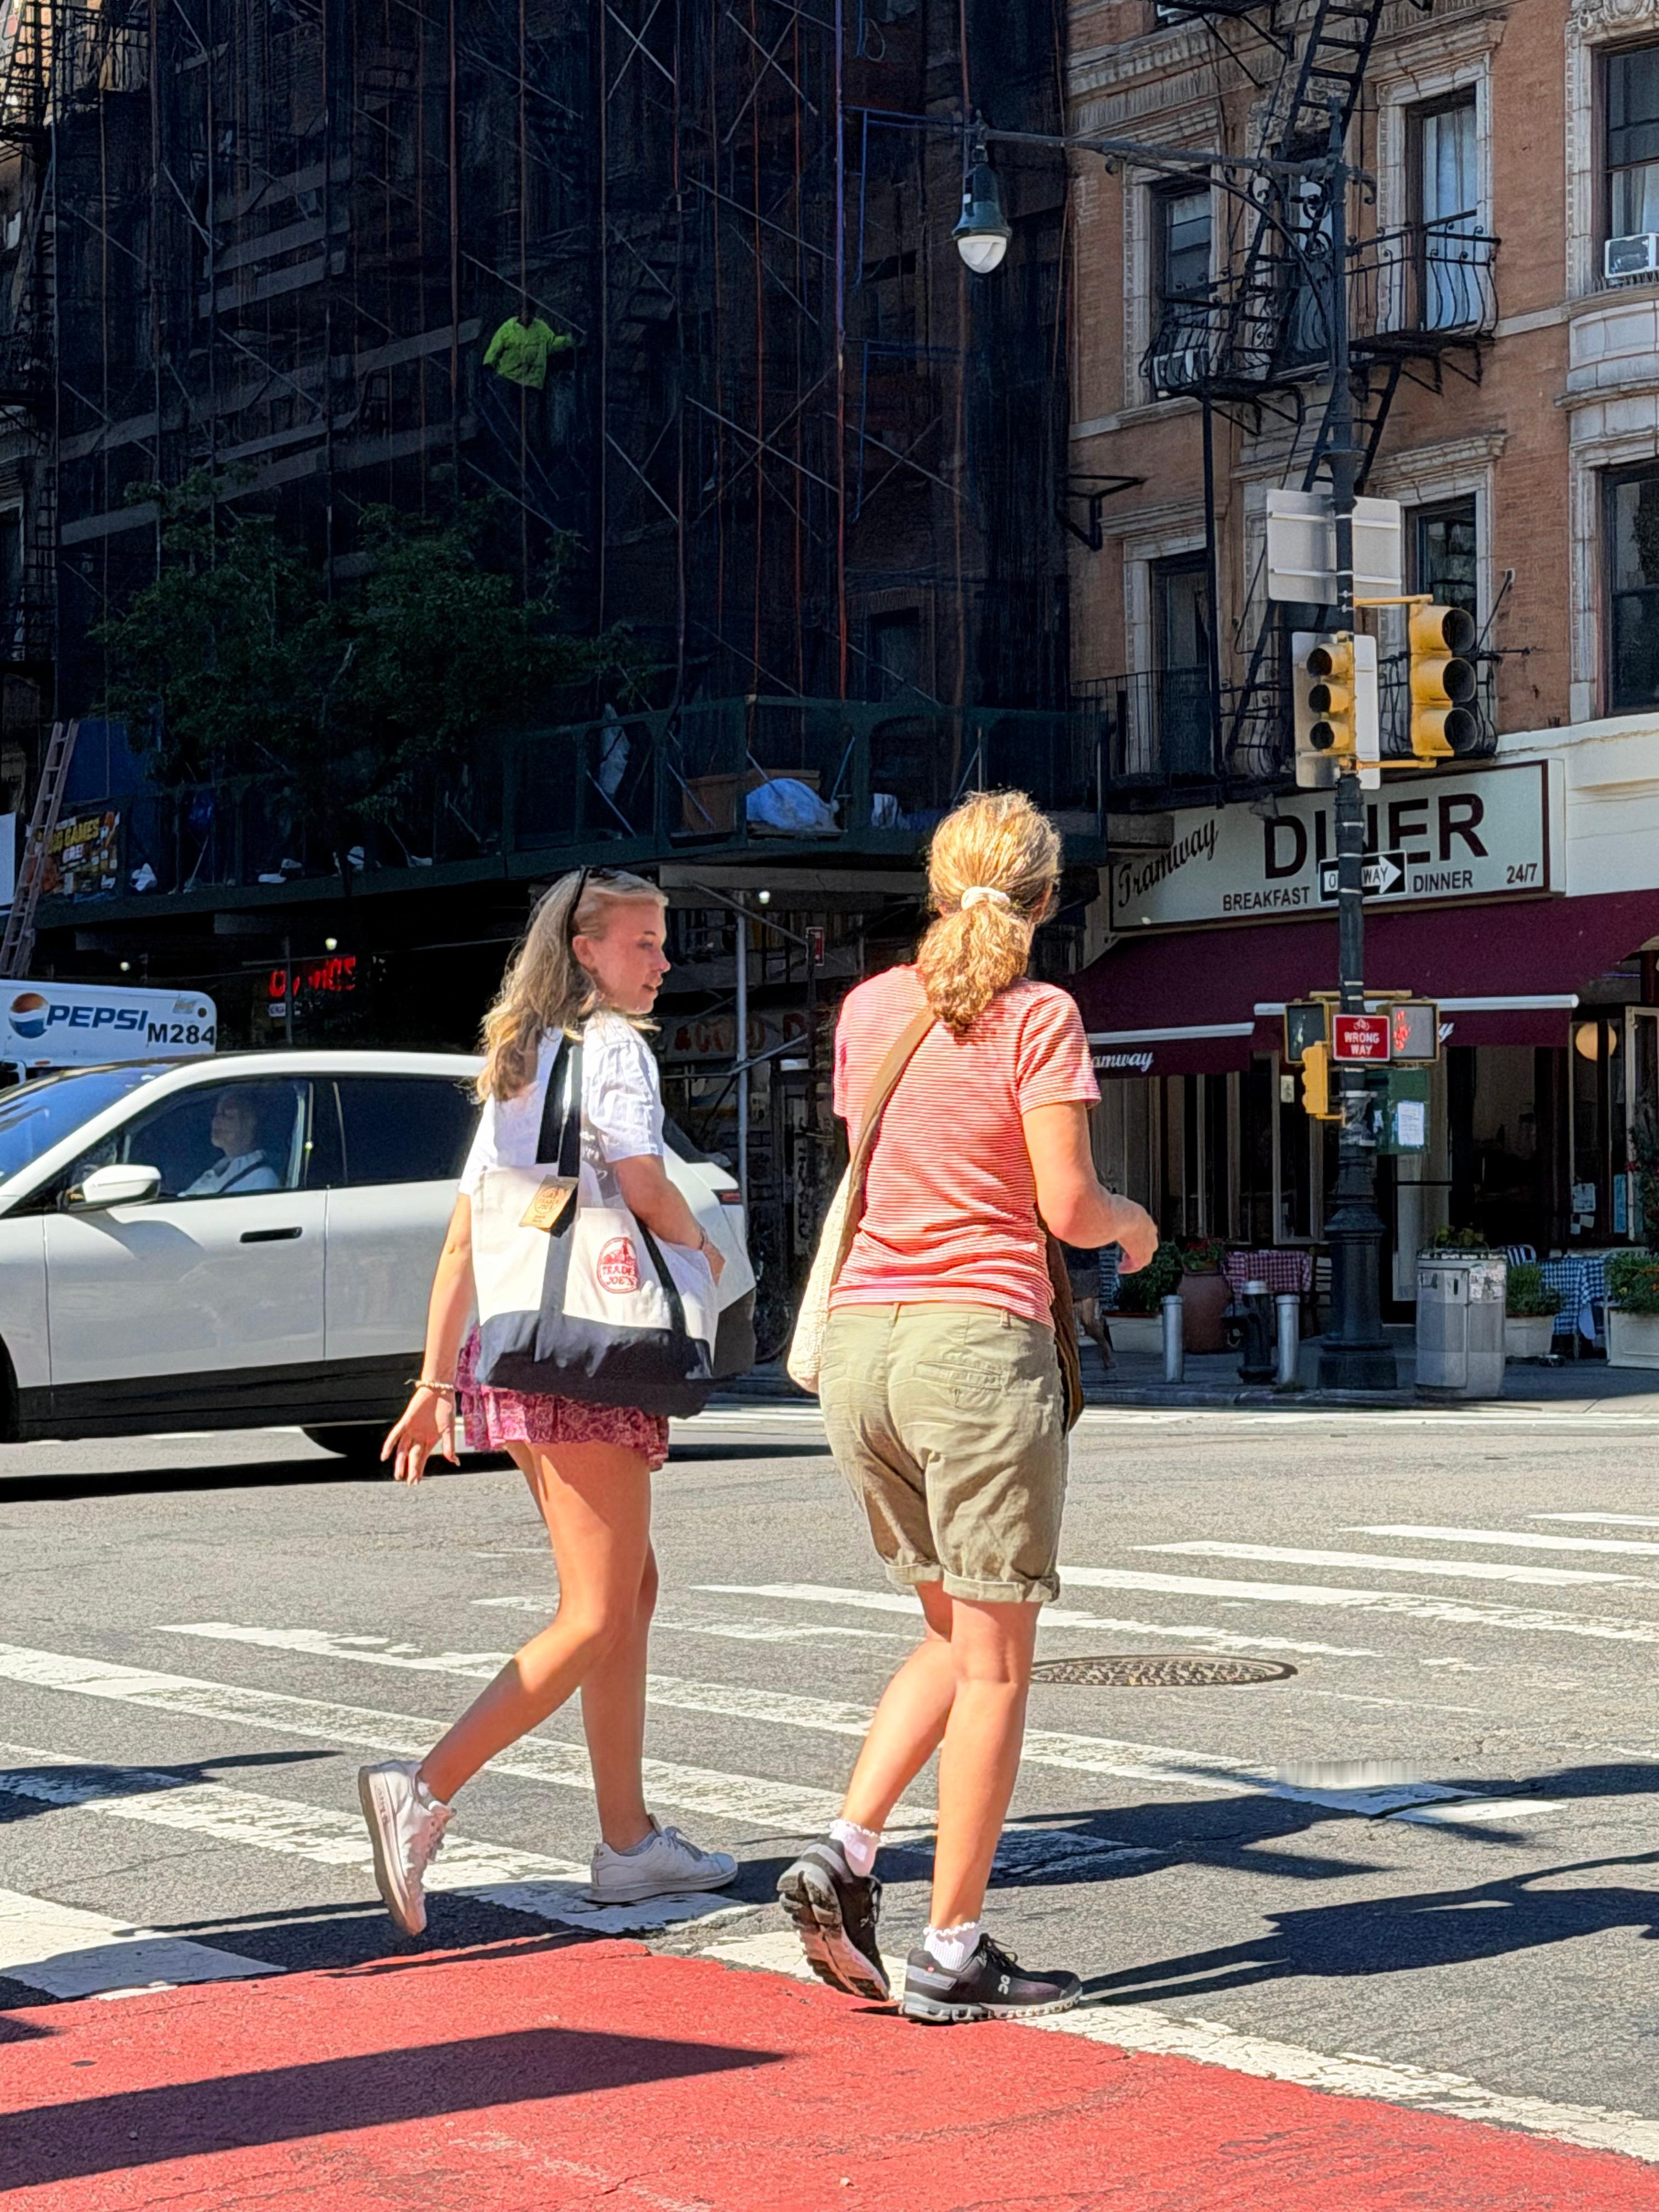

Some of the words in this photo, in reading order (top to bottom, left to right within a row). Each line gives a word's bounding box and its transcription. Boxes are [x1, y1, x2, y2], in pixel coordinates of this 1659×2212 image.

[1118, 819, 1219, 908] Tramway
[1506, 862, 1538, 884] 24/7
[1363, 866, 1389, 884] WAY
[1223, 886, 1310, 911] BREAKFAST
[1413, 870, 1474, 893] DINNER
[46, 1005, 149, 1031] PEPSI
[148, 1023, 215, 1046] M284
[1344, 1031, 1380, 1043] WRONG
[1350, 1044, 1373, 1056] WAY
[1092, 1051, 1154, 1073] amway
